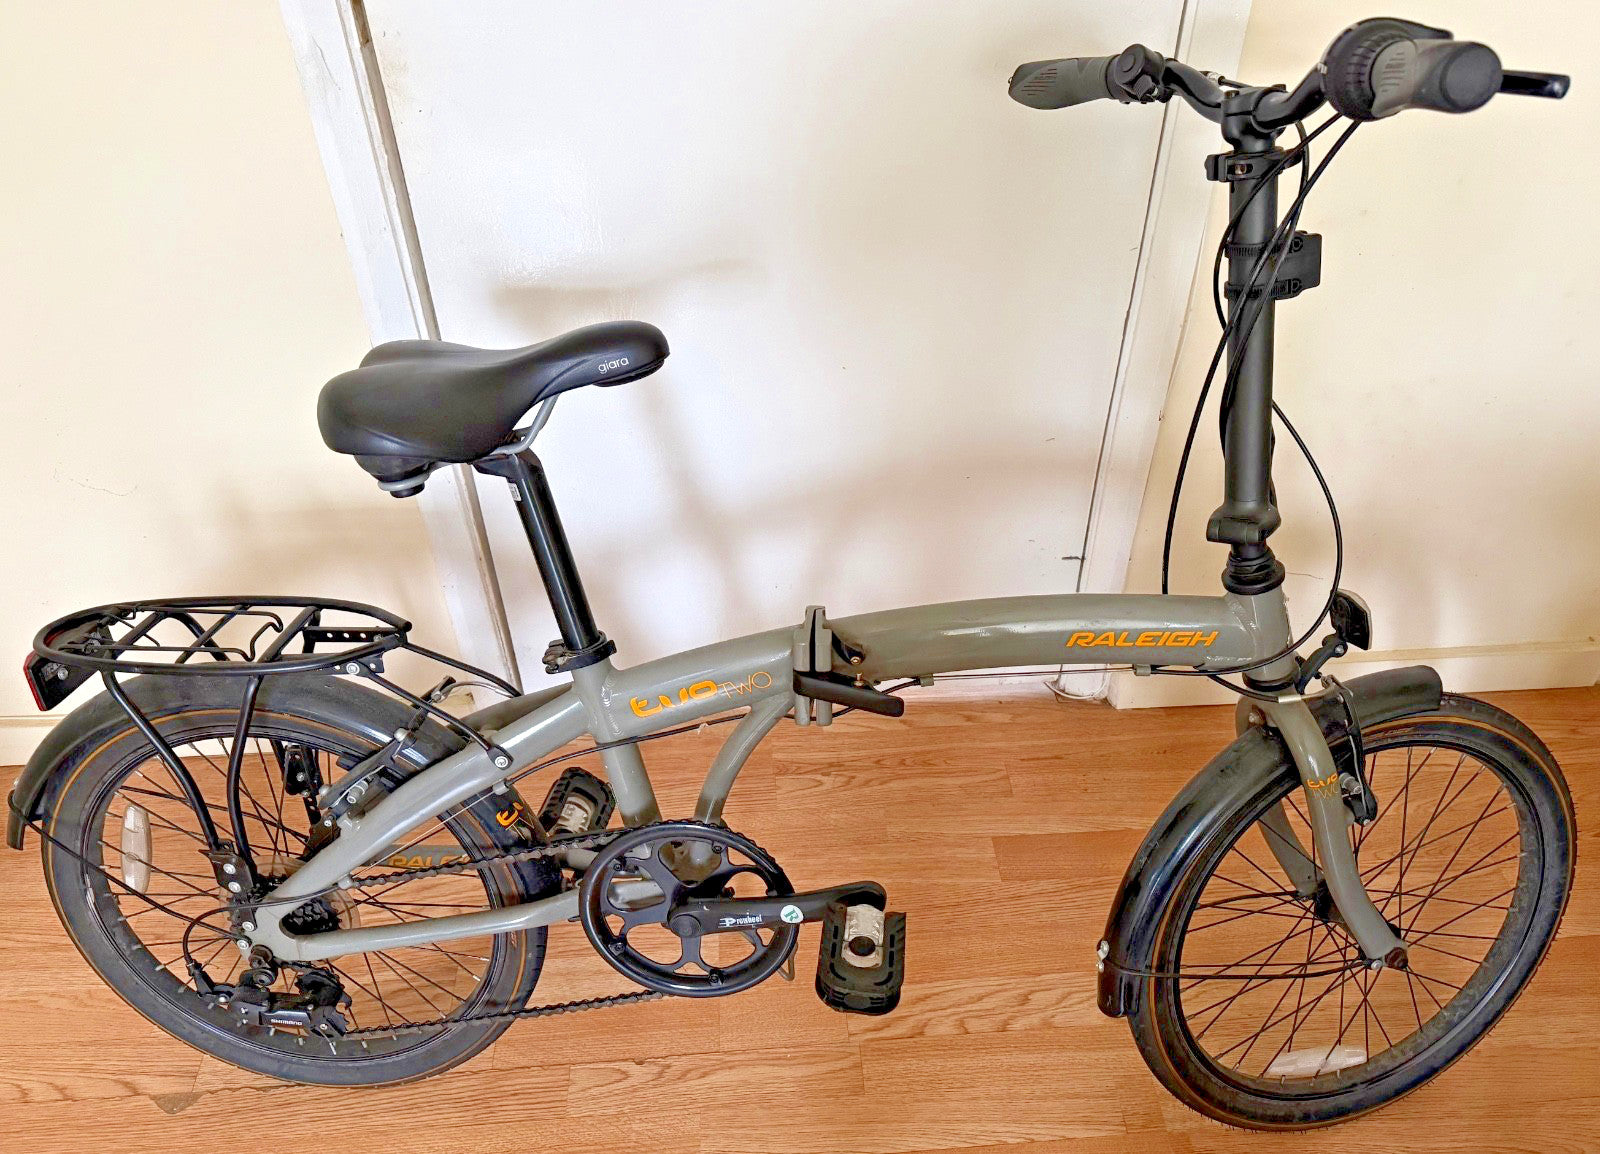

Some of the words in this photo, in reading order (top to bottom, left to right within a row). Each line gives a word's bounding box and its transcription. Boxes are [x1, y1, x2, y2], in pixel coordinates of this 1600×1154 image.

[598, 357, 630, 375] giara
[1065, 631, 1219, 648] RALEIGH
[717, 671, 772, 699] TWO
[271, 1018, 303, 1026] SHIMANO
